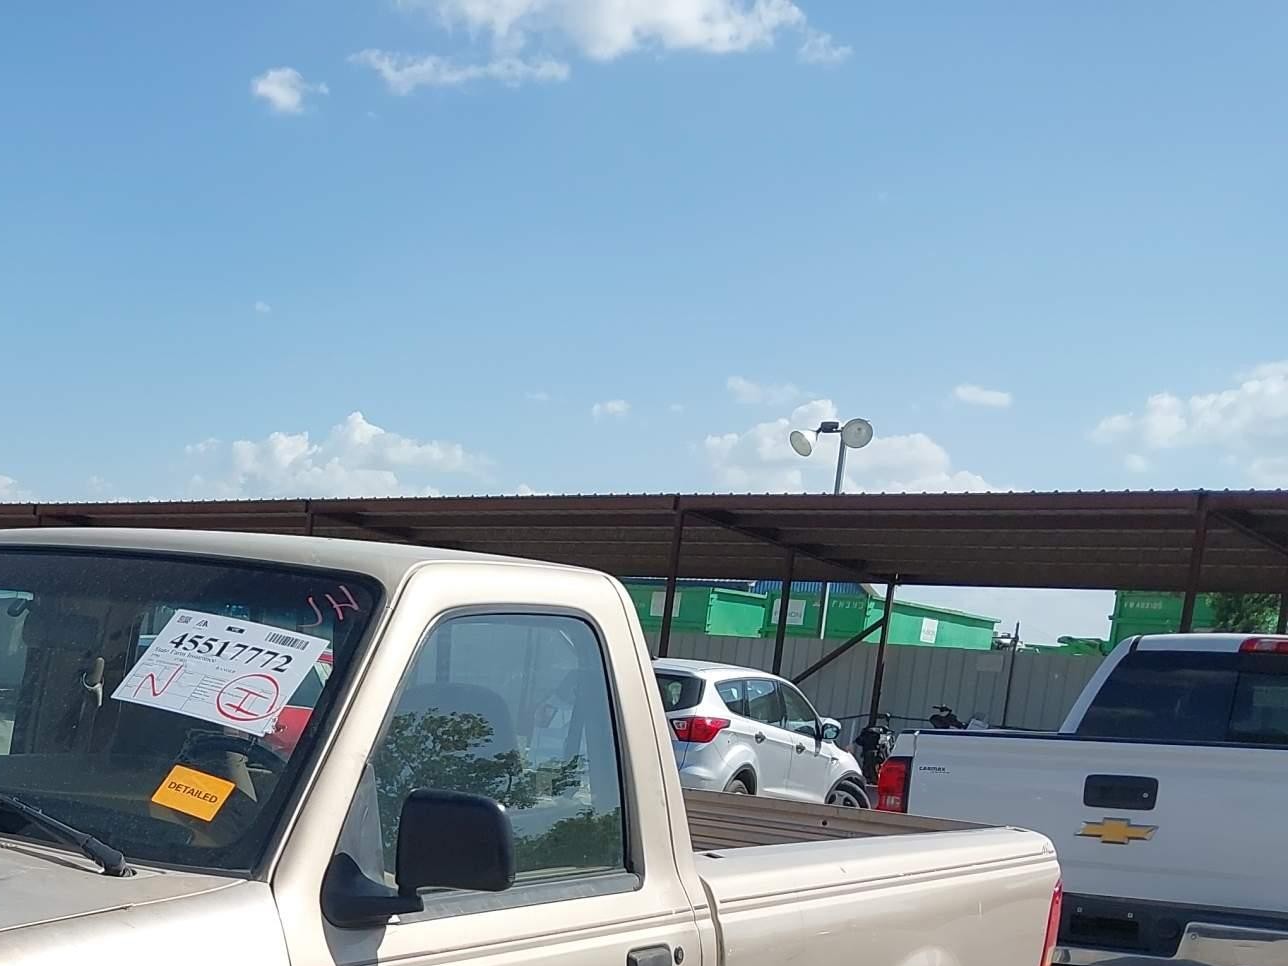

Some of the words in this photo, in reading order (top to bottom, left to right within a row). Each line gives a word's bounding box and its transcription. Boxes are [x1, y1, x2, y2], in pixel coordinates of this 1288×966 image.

[169, 632, 294, 673] 45517772
[133, 664, 184, 698] N
[167, 781, 218, 803] DETAILED
